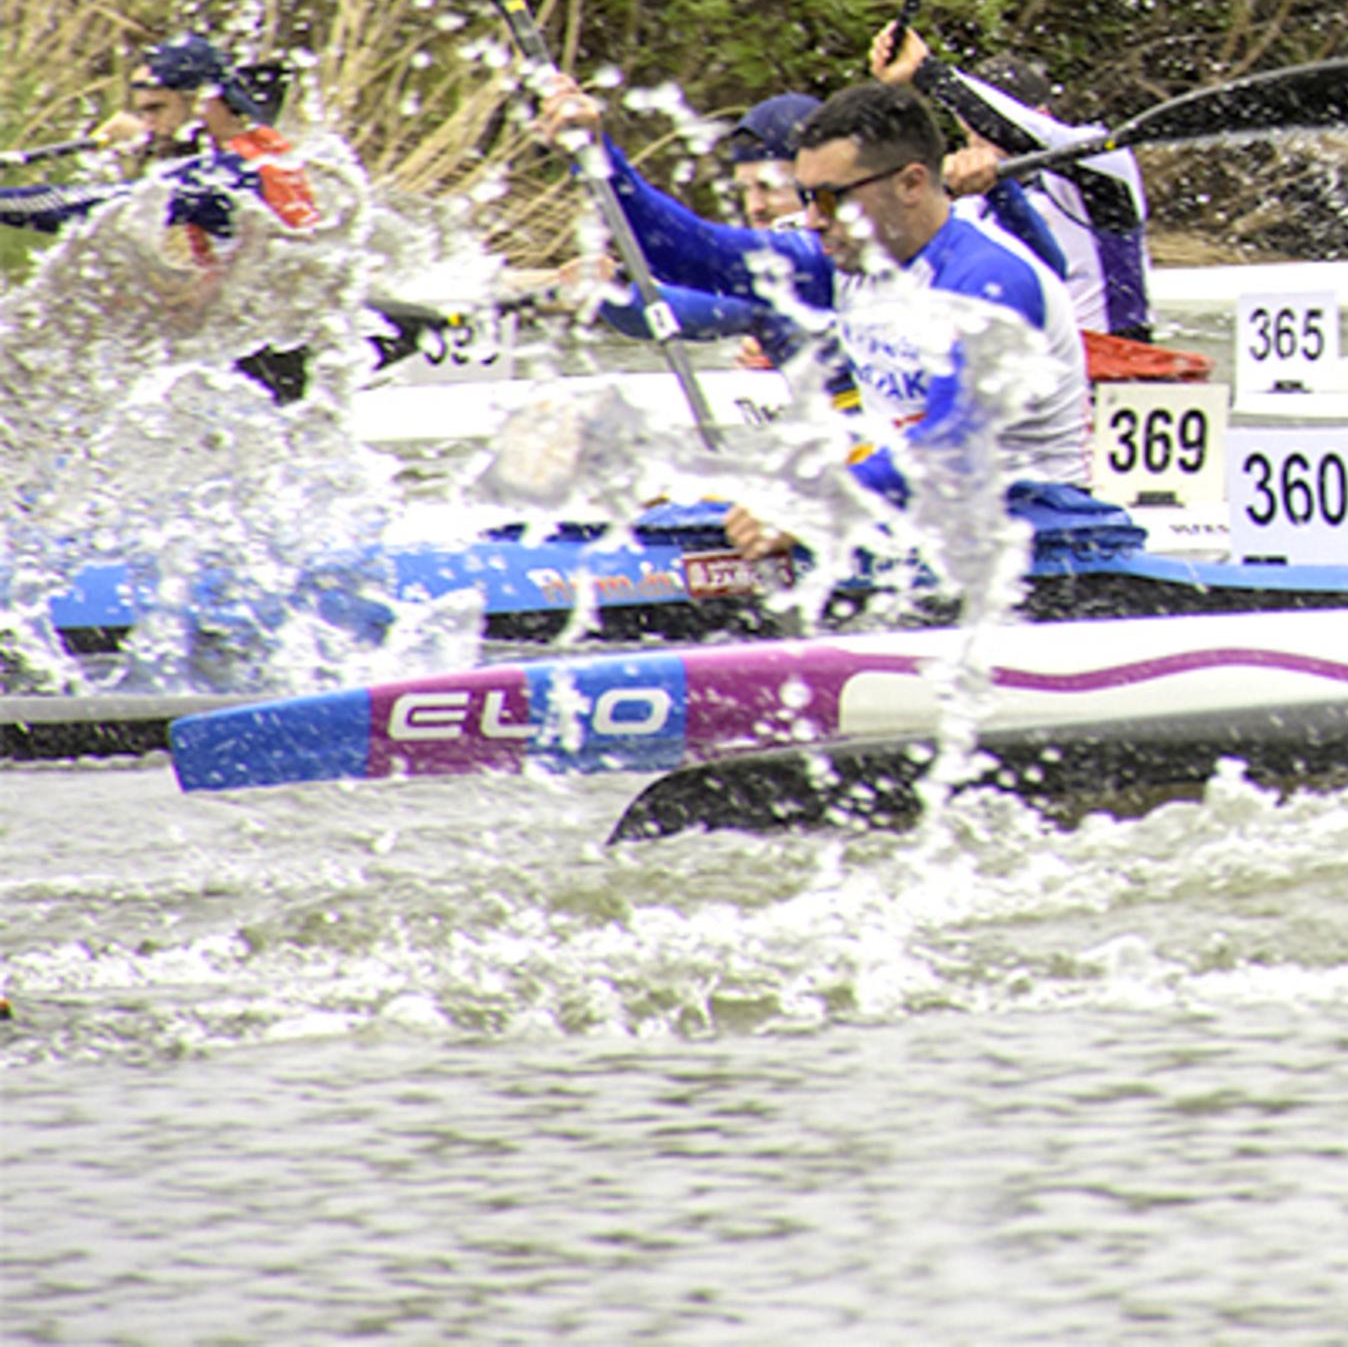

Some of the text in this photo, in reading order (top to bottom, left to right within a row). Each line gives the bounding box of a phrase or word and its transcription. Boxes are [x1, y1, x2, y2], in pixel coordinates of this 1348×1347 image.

[1249, 308, 1324, 361] 365
[1108, 408, 1208, 474] 369
[1242, 452, 1348, 527] 360
[387, 688, 671, 740] ELO
